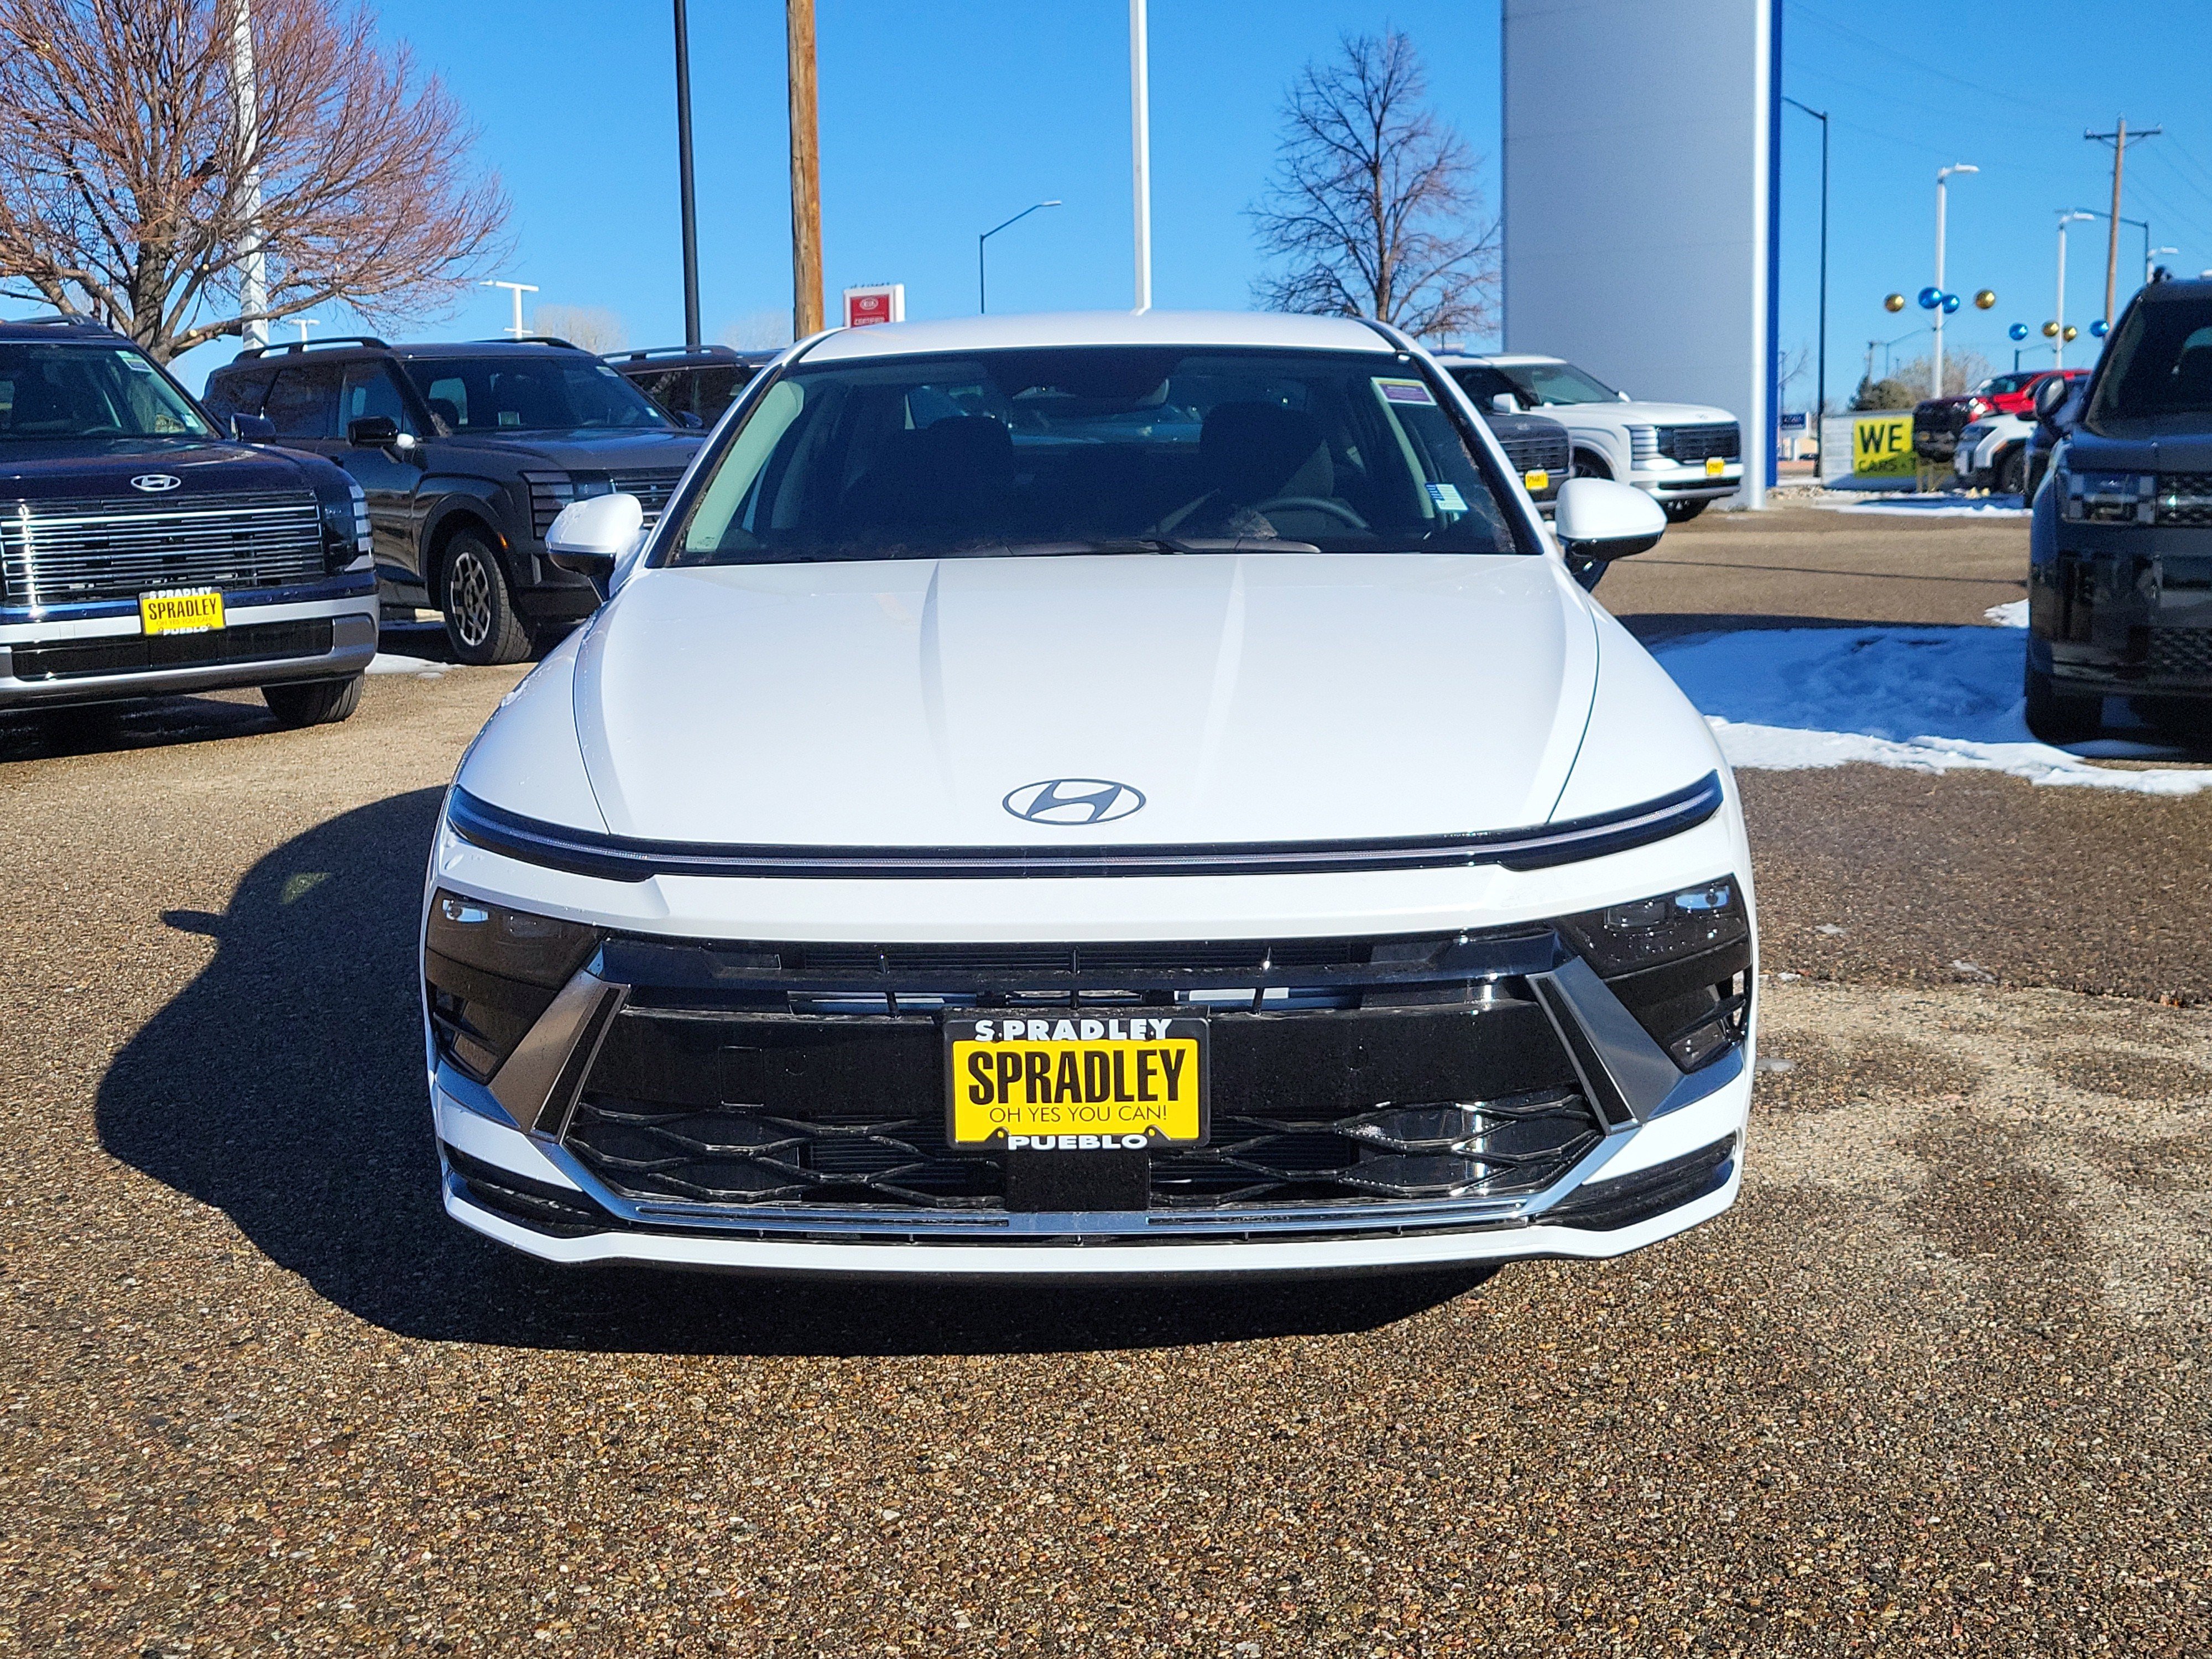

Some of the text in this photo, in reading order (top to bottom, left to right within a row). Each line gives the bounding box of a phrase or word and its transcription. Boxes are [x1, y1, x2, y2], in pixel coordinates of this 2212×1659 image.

[1859, 424, 1903, 453] WE
[149, 586, 212, 599] SPRADLEY
[148, 598, 216, 620] SPRADLEY
[163, 625, 208, 635] PUEBLO
[975, 1018, 1172, 1041] SPRADLEY
[968, 1048, 1186, 1105] SPRADLEY
[989, 1104, 1167, 1123] OH YES YOU CAN!
[1008, 1134, 1148, 1150] PUEBLO
